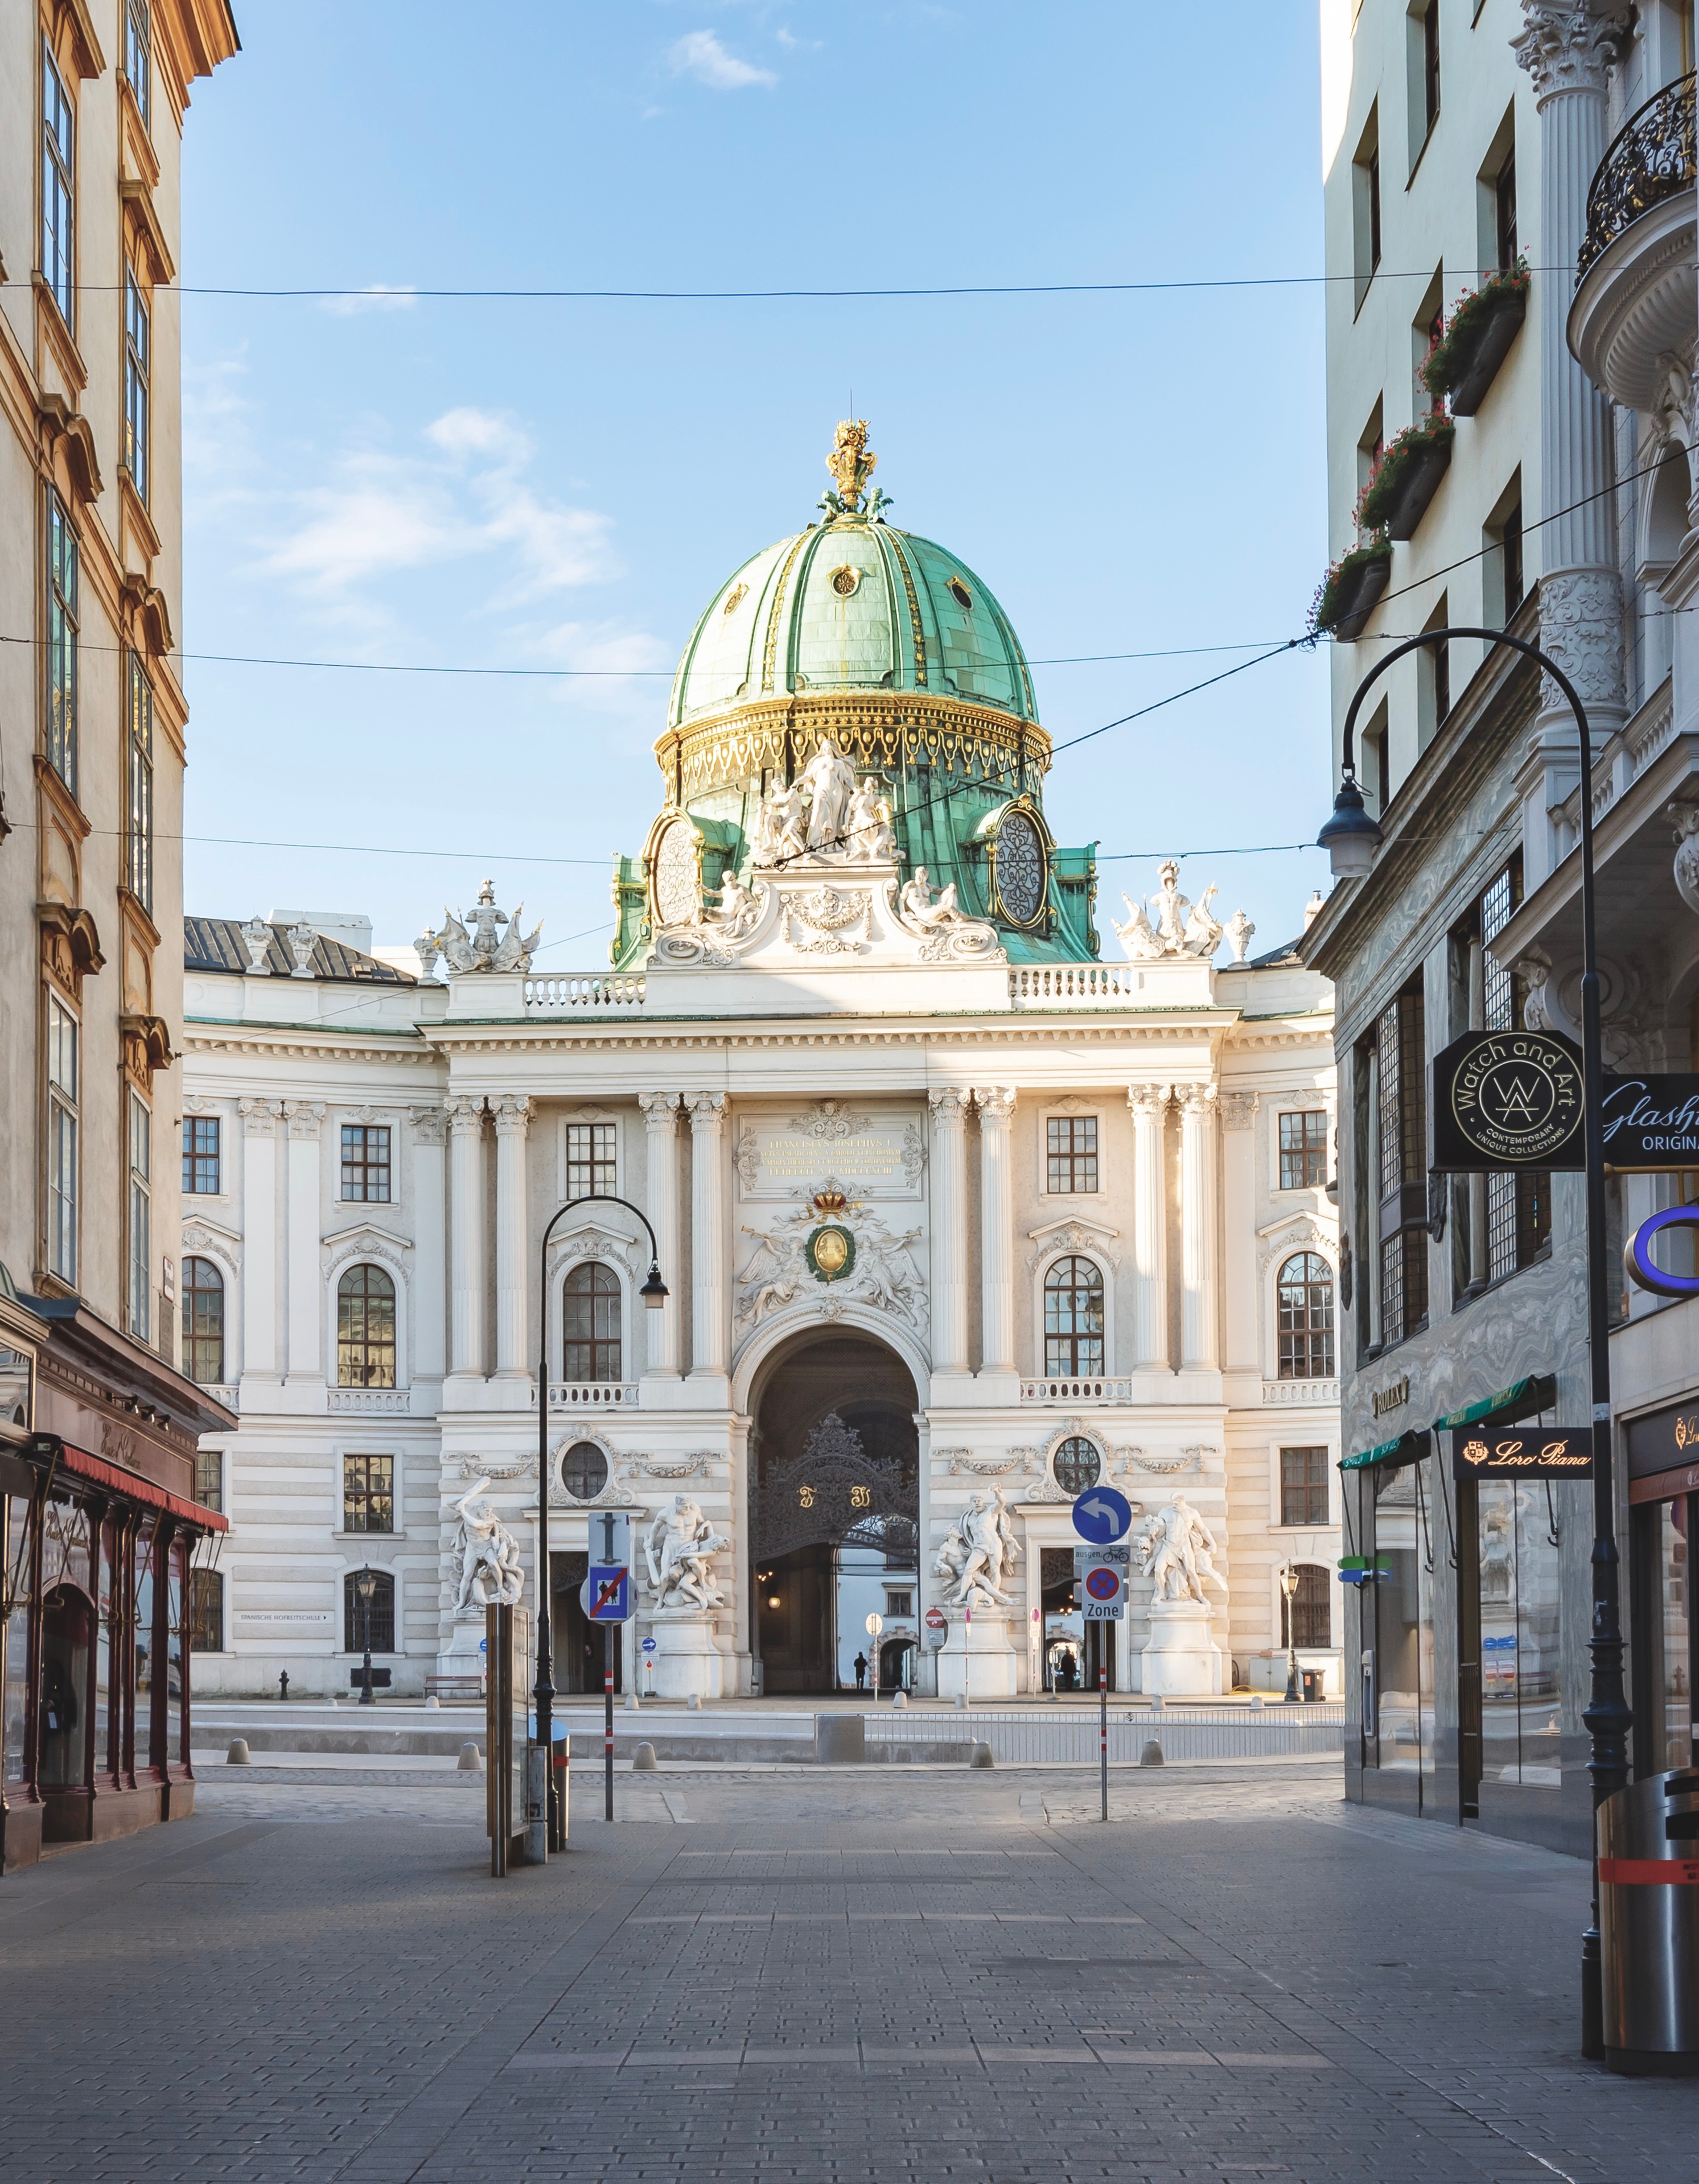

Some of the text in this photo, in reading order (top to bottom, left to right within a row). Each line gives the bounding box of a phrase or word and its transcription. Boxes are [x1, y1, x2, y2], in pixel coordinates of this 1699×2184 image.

[1457, 1042, 1575, 1110] Watch and Art
[1602, 1081, 1699, 1143] Glash
[1476, 1127, 1565, 1154] UNIQUE COLLECTIONS
[1486, 1123, 1554, 1144] CONTEMPORARY
[1642, 1136, 1699, 1150] ORIGIN
[1378, 1383, 1401, 1414] ROLEX
[1488, 1440, 1591, 1465] Loro Piana
[1088, 1604, 1118, 1617] Zone
